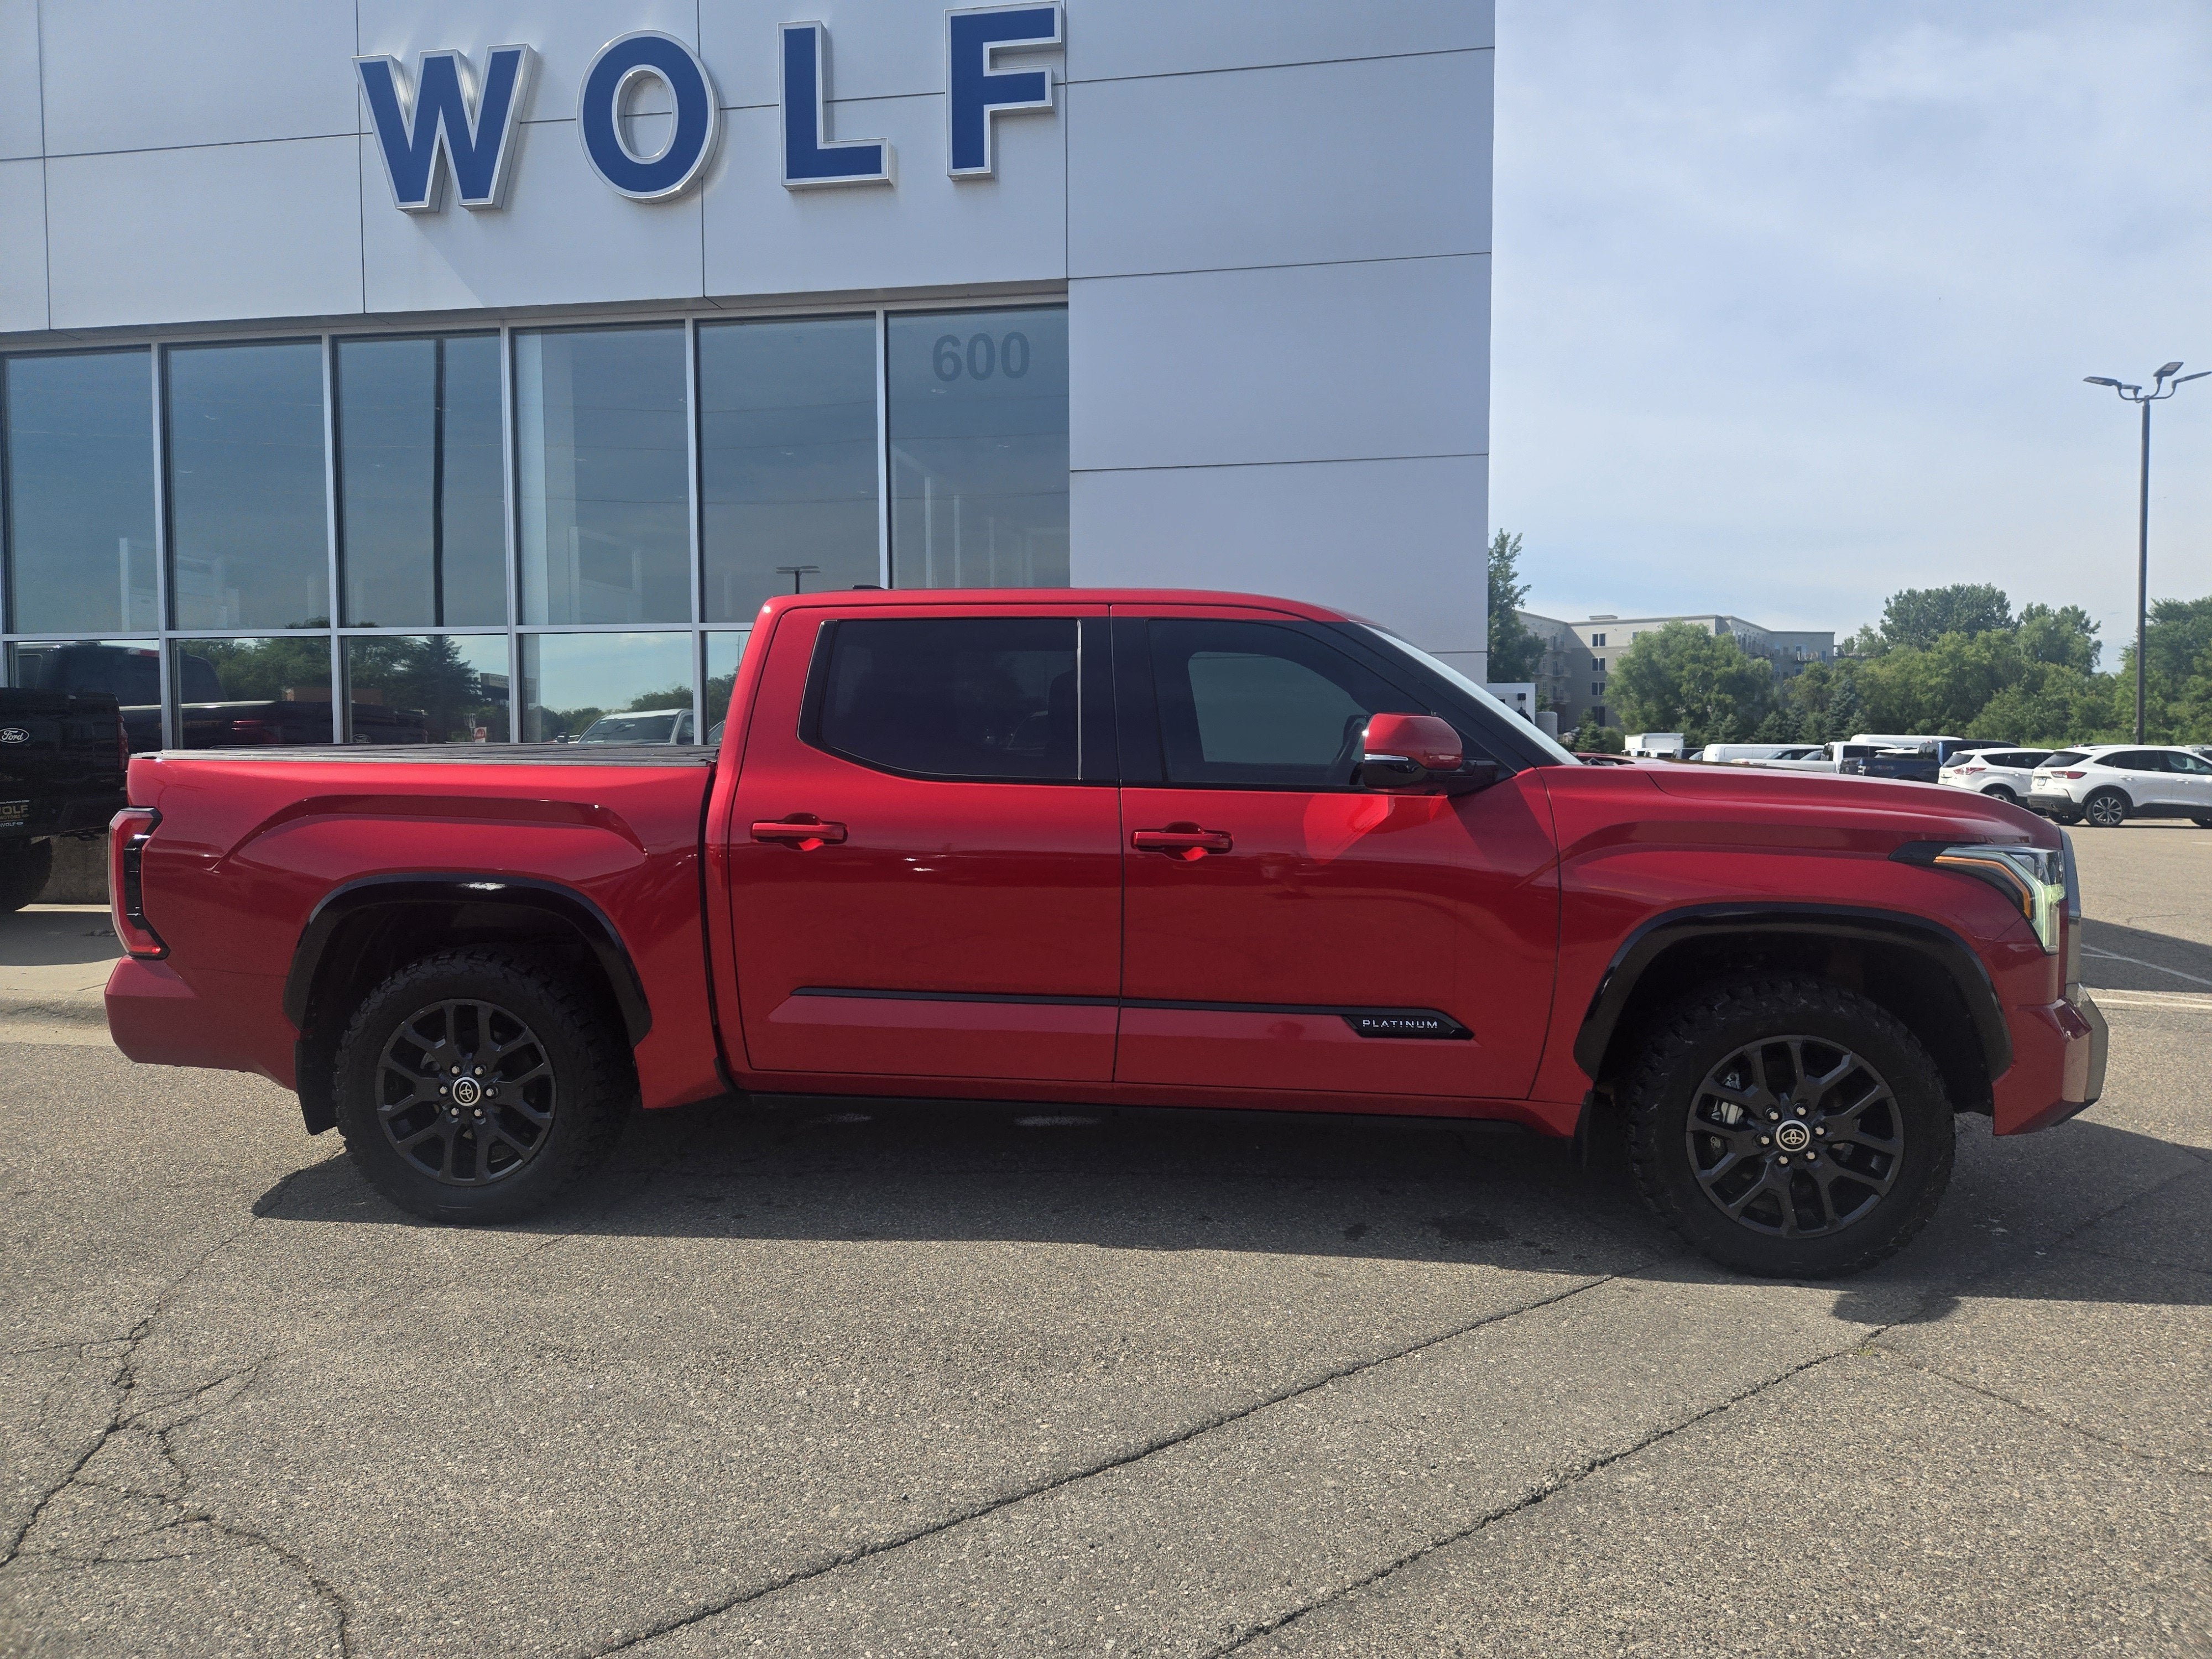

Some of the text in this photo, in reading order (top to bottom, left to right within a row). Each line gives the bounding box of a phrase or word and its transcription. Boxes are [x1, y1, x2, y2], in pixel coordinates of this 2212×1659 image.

[351, 1, 1065, 213] WOLF
[933, 332, 1030, 382] 600
[1, 730, 24, 740] Ford
[0, 805, 29, 815] OLF
[1362, 1020, 1437, 1029] PLATINUM
